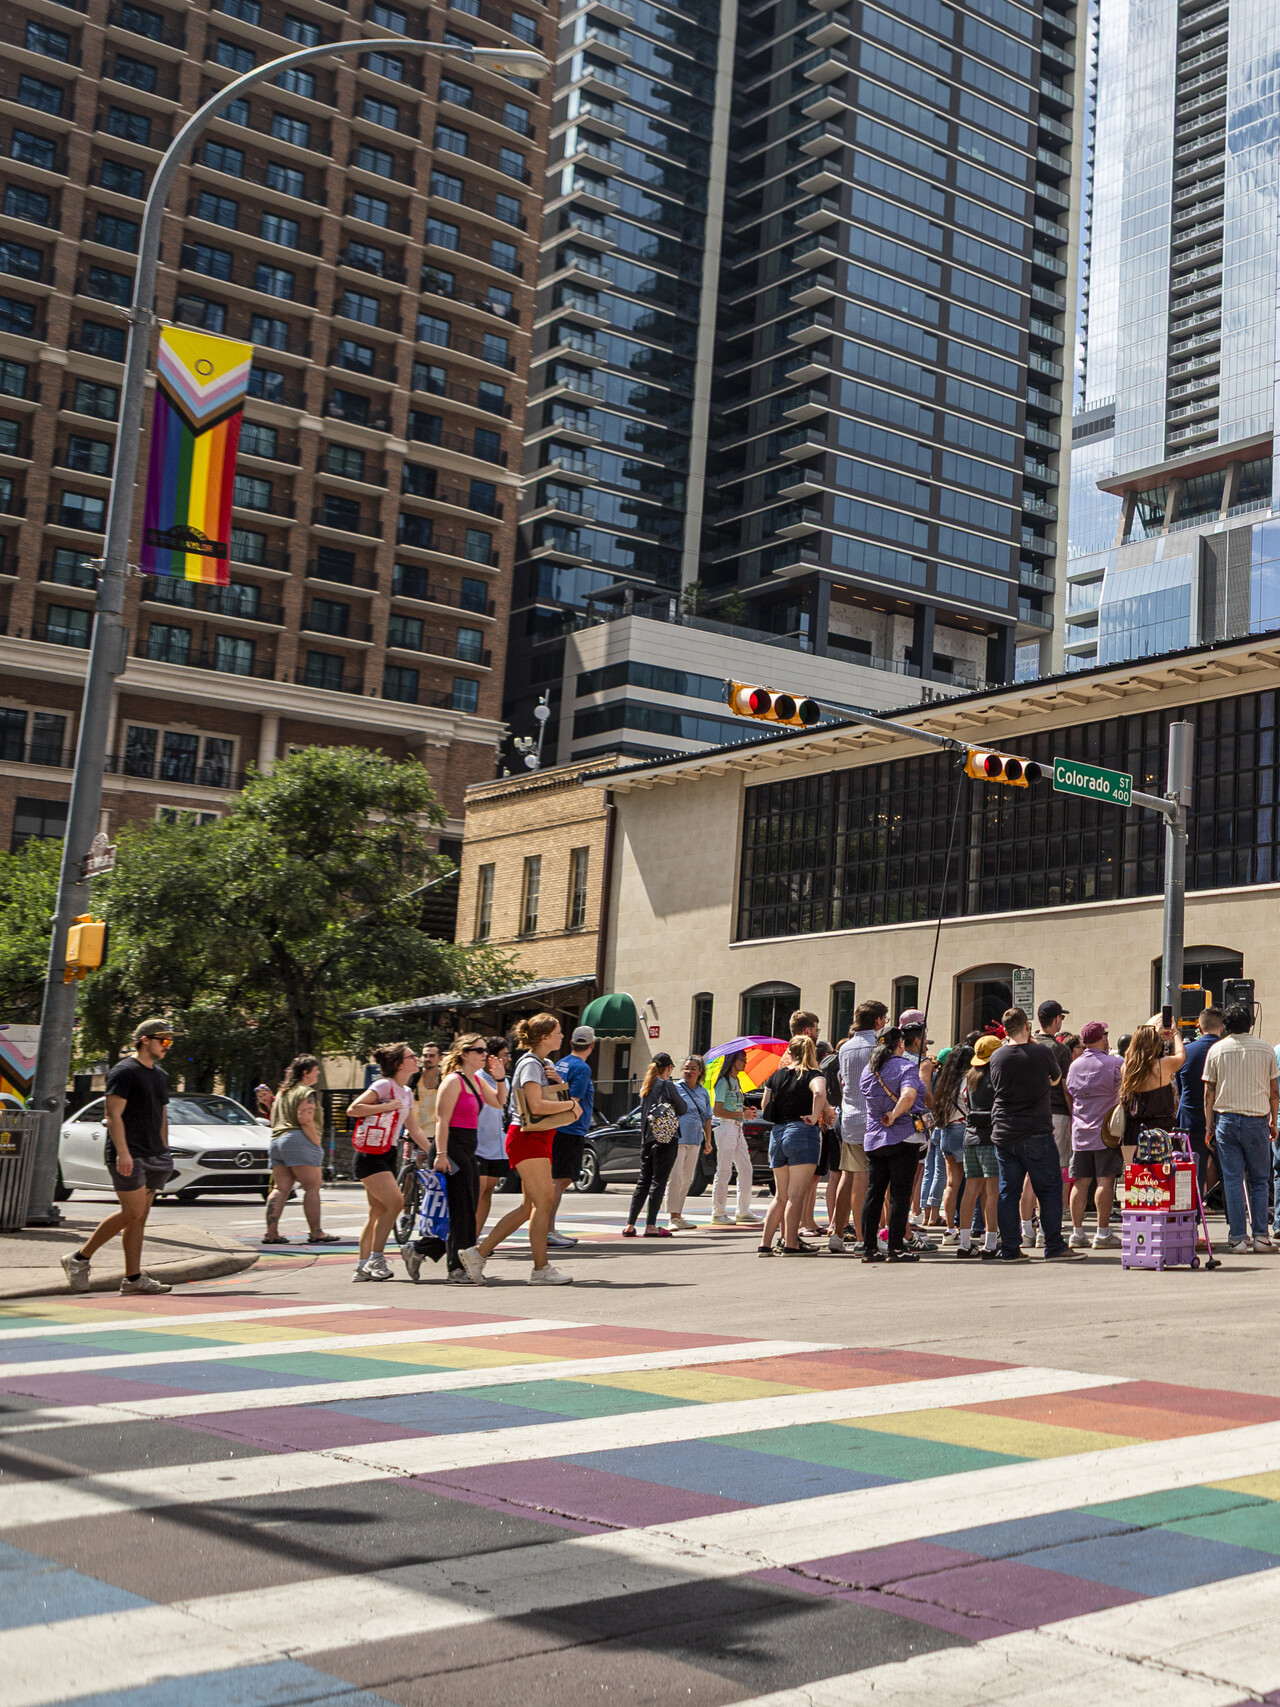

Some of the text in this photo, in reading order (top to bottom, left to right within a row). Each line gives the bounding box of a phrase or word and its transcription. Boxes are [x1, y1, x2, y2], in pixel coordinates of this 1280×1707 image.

[1056, 766, 1130, 793] Colorado ST
[1112, 789, 1129, 802] 400
